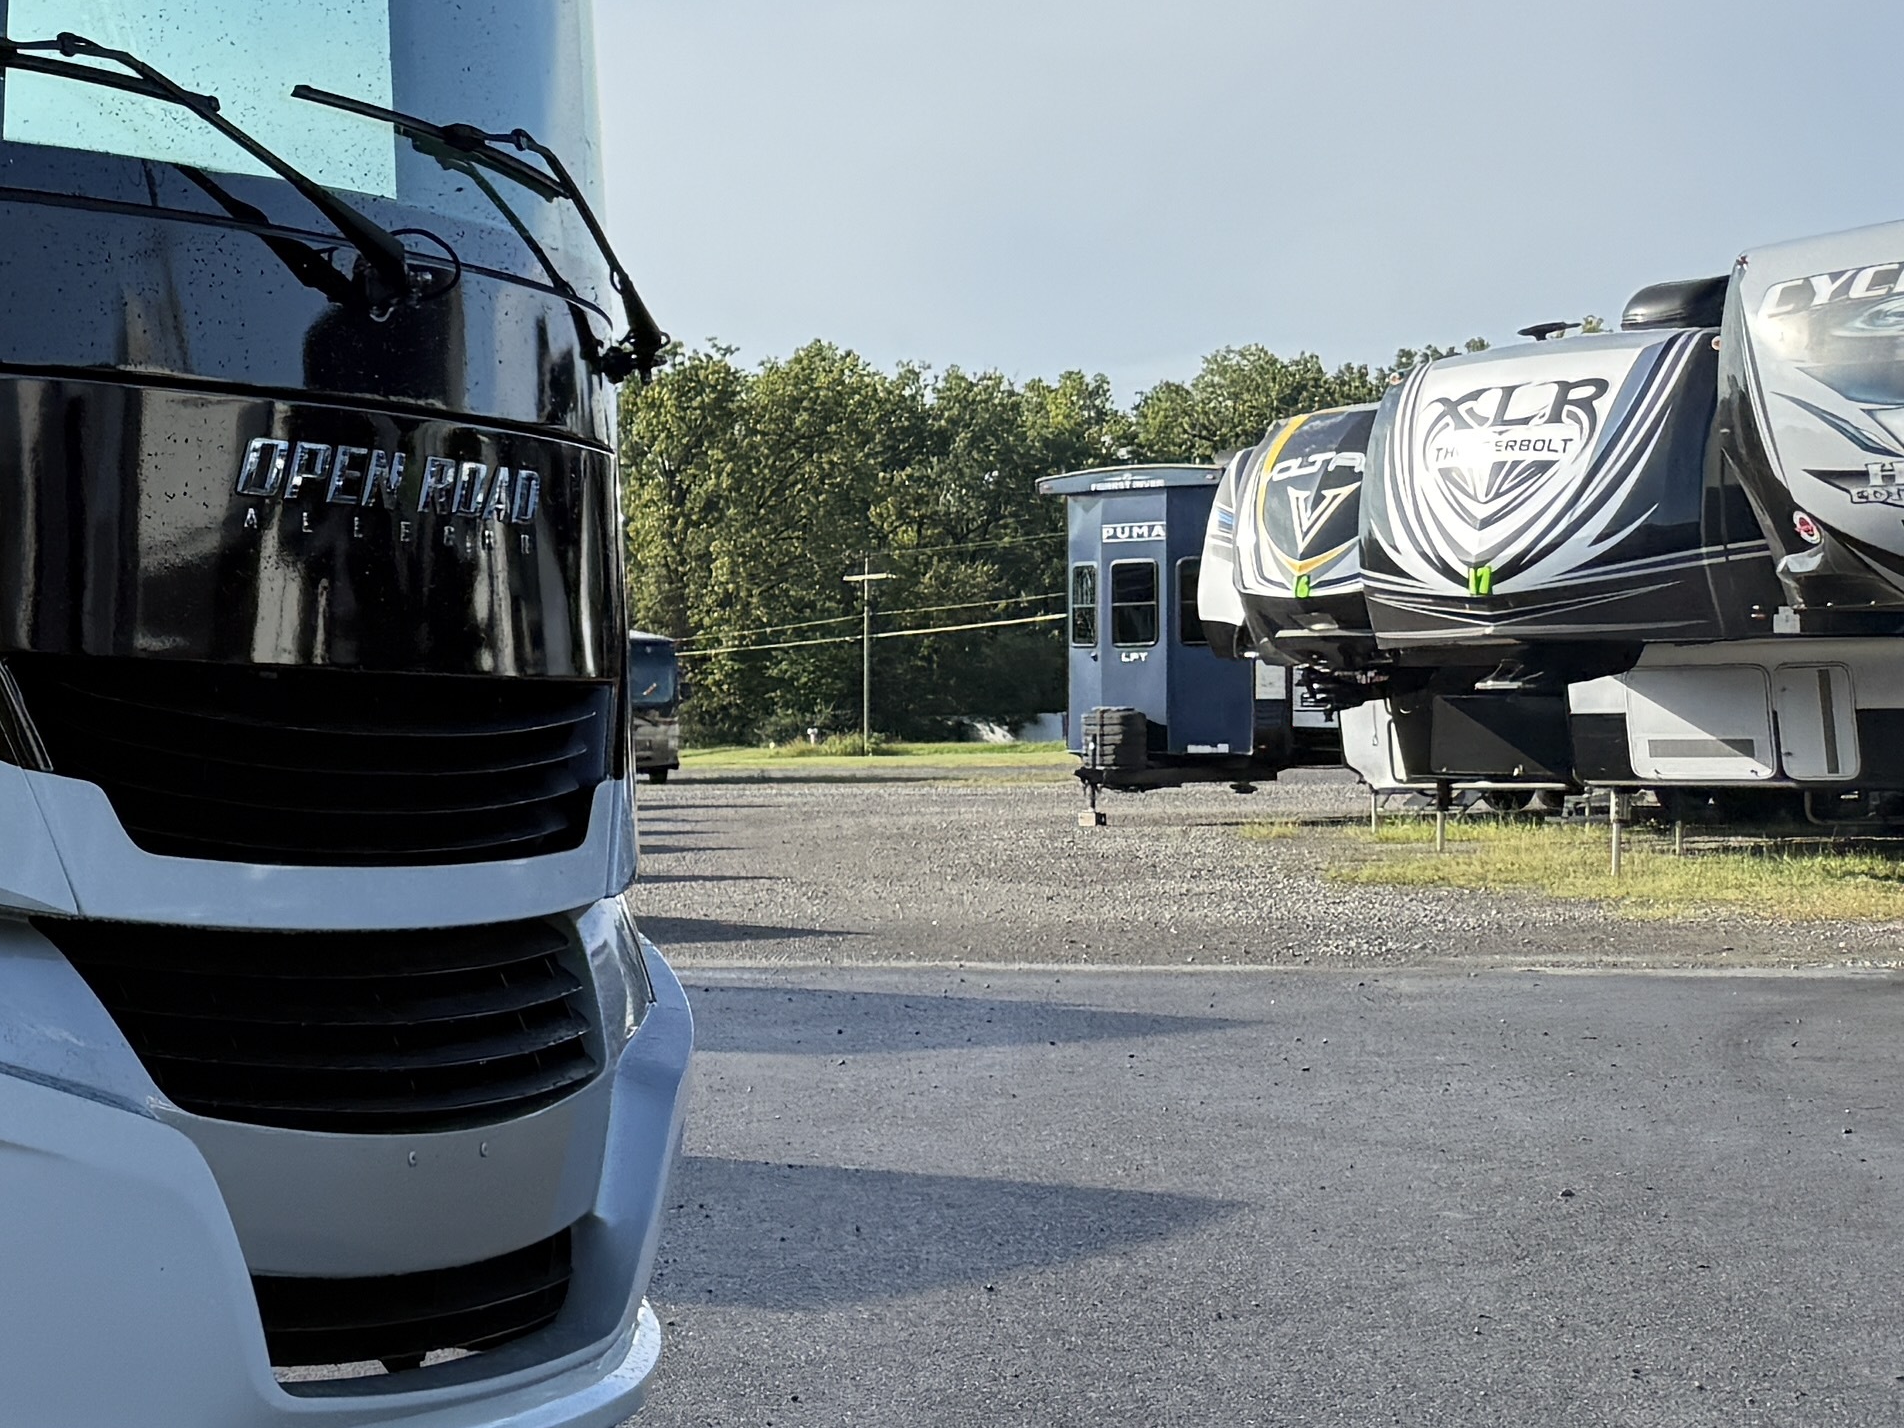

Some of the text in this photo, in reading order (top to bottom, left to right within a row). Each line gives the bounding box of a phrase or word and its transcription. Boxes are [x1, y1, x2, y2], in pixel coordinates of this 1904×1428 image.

[1424, 377, 1610, 434] XLR
[1435, 438, 1574, 463] THERBOLT
[236, 437, 541, 523] OPEN ROAD
[1268, 451, 1367, 482] OLTA
[1102, 524, 1167, 540] PUMA
[1468, 566, 1491, 595] 17
